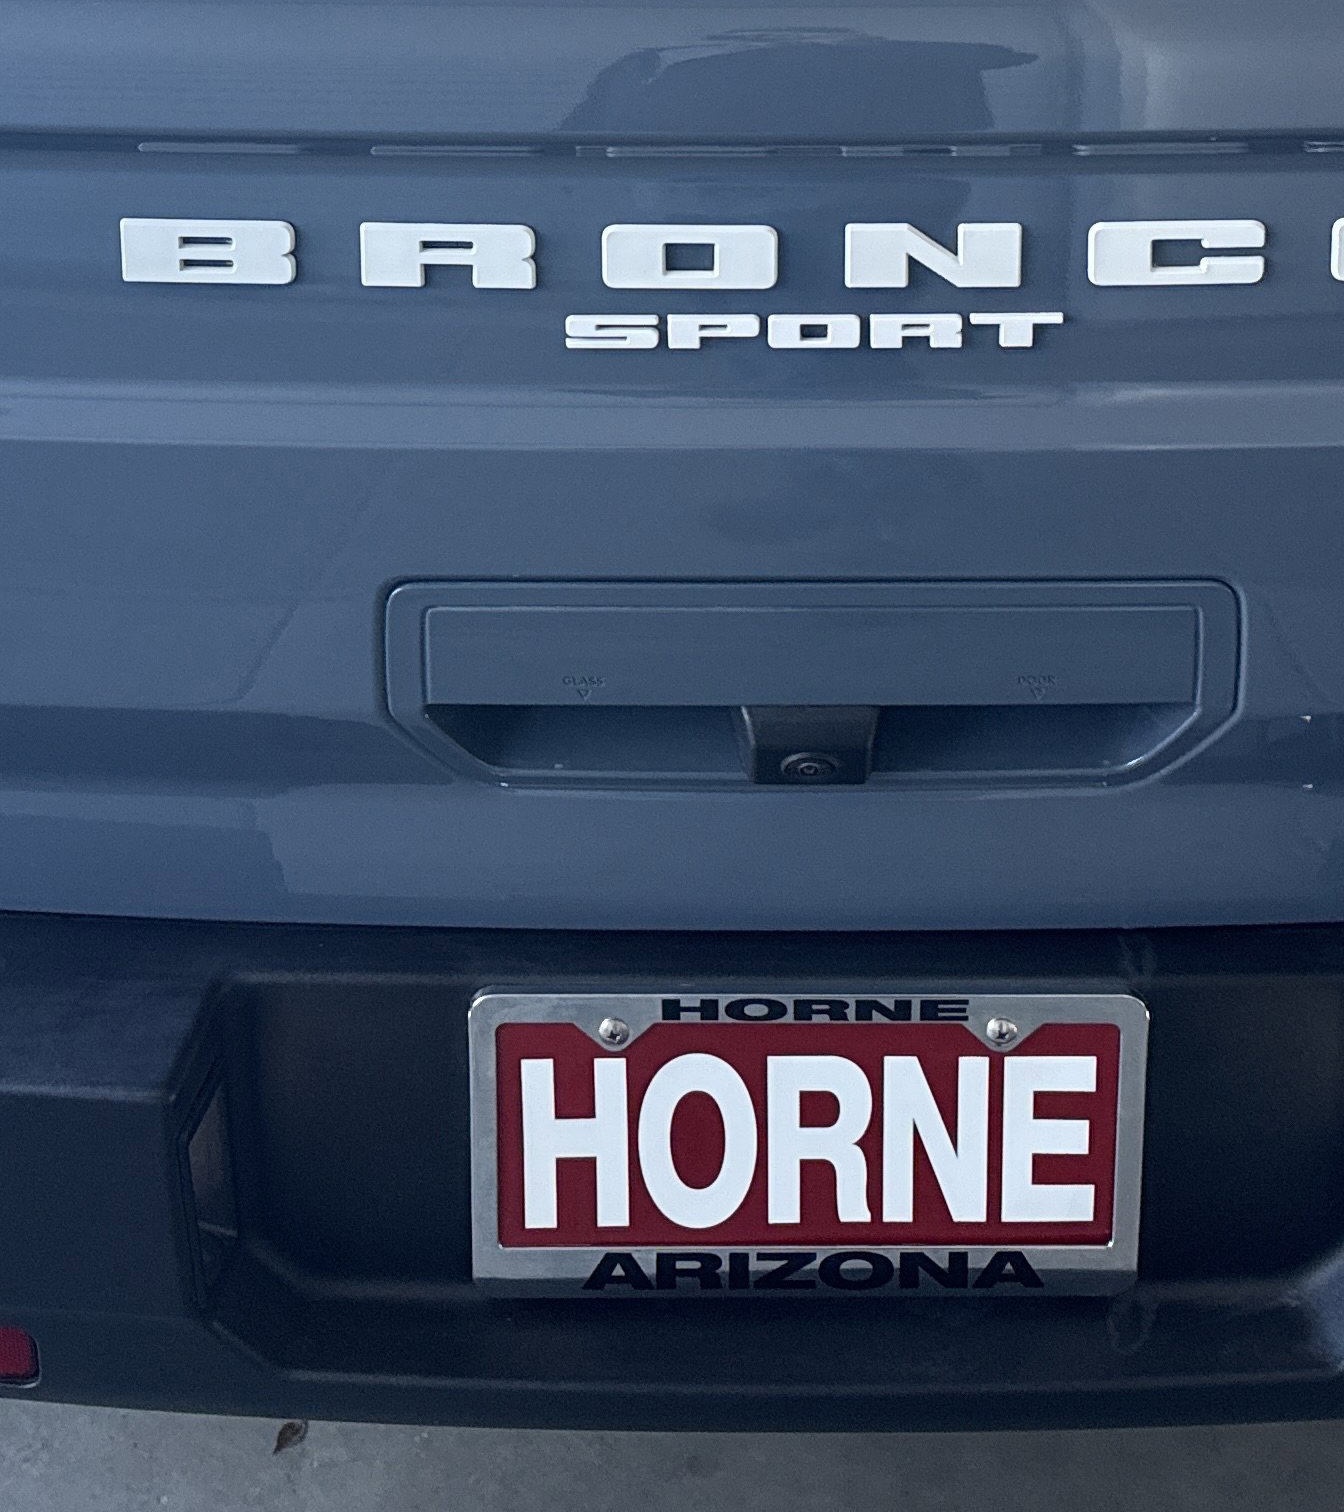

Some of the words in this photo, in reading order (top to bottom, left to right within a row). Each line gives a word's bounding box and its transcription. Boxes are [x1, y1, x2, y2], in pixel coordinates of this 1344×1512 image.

[564, 311, 1064, 351] SPORT
[562, 675, 606, 687] GLASS
[1017, 675, 1057, 686] DOOR
[660, 998, 971, 1022] HORNE
[520, 1053, 1098, 1229] HORNE
[582, 1251, 1046, 1290] ARIZONA
